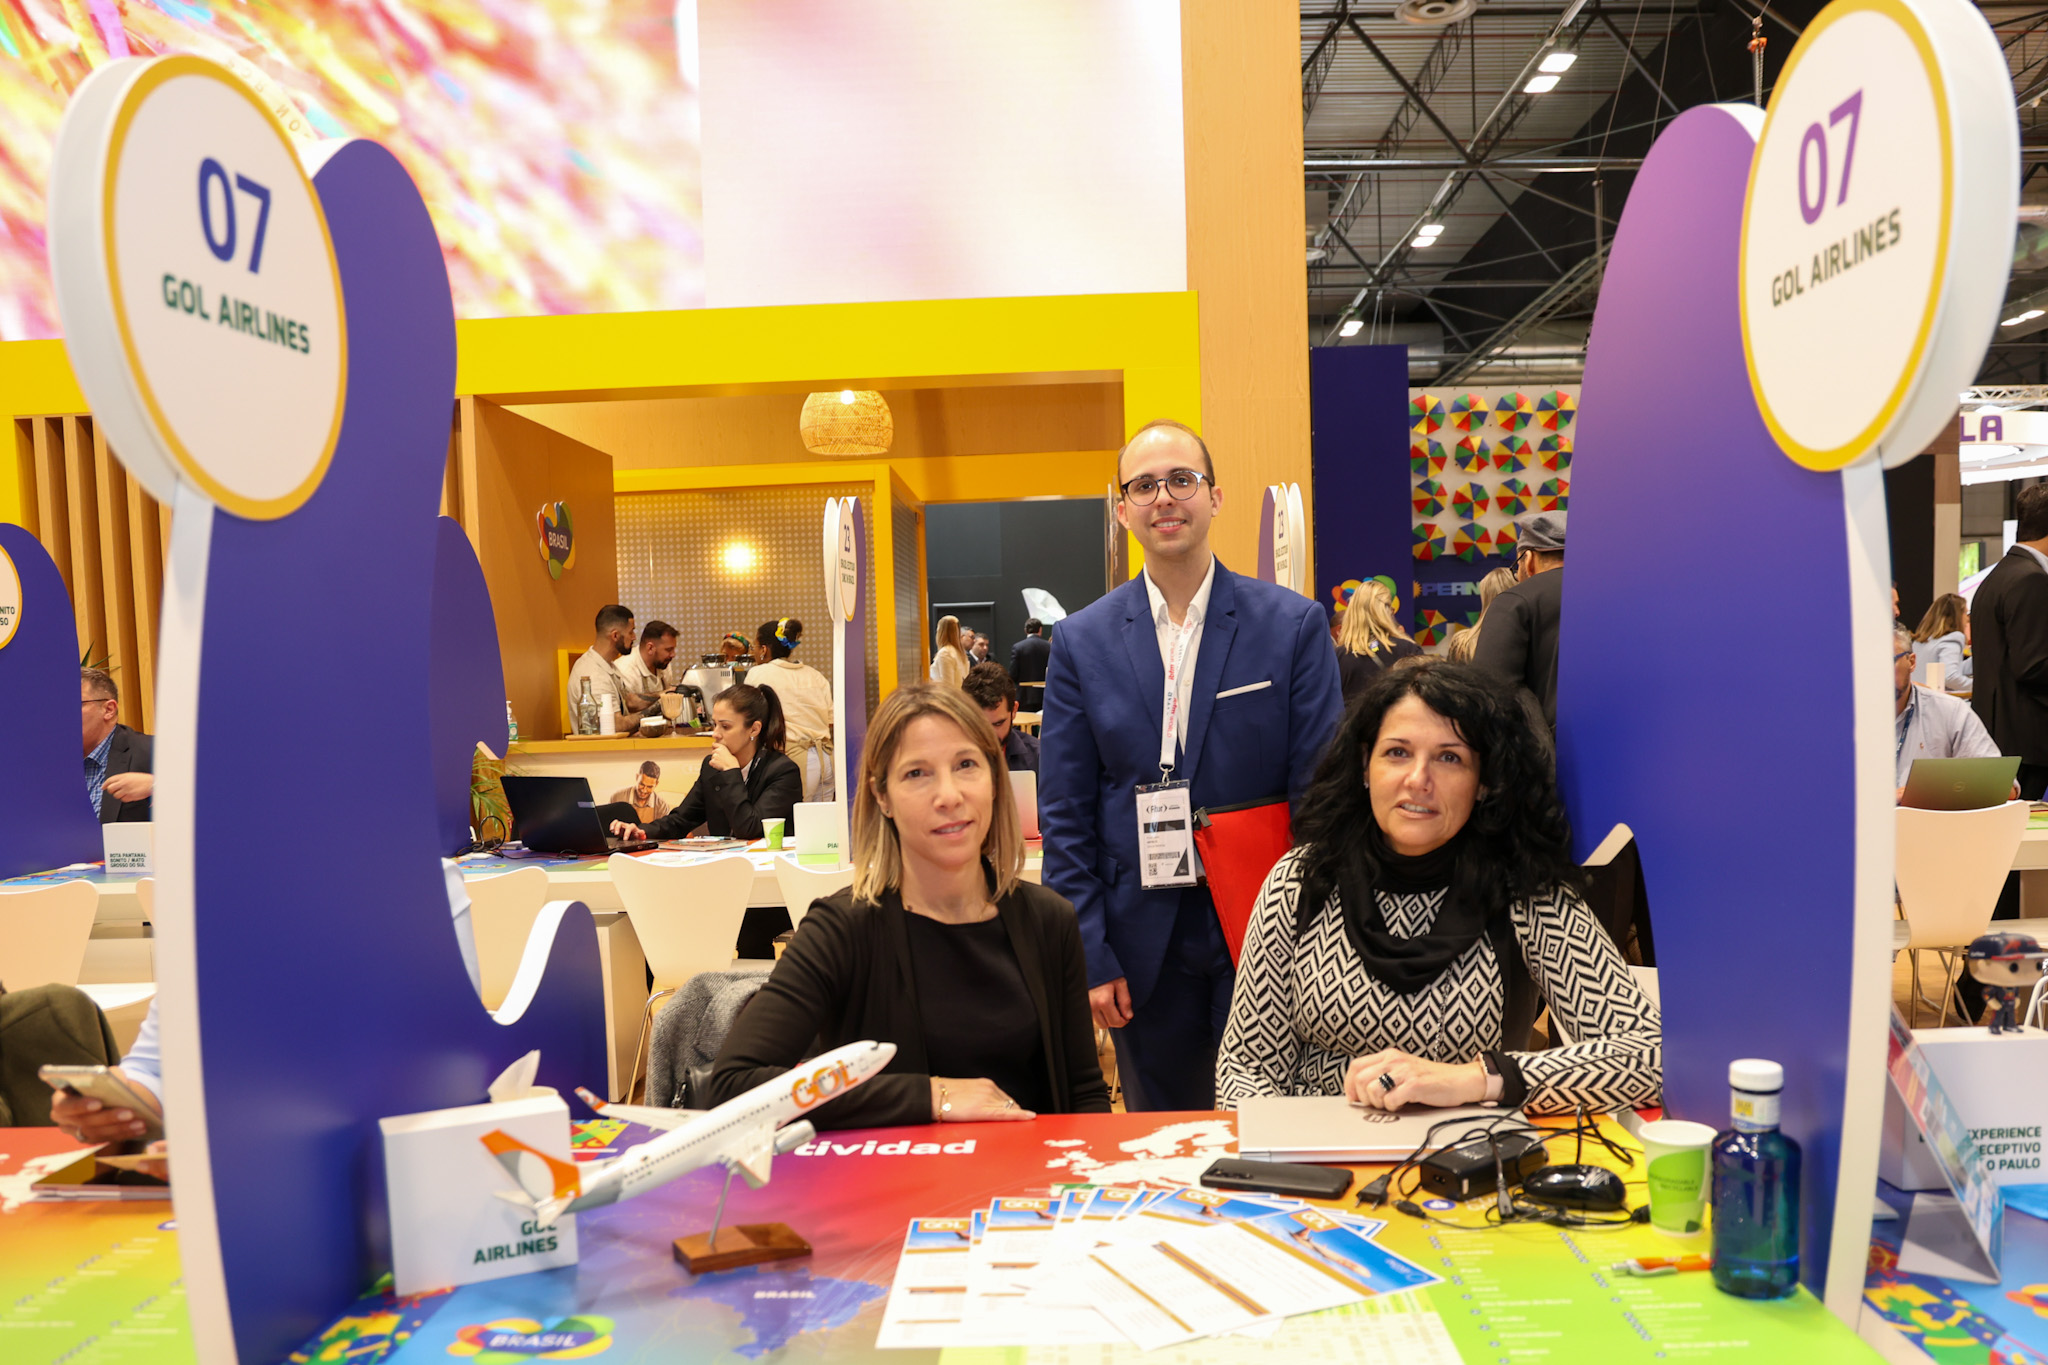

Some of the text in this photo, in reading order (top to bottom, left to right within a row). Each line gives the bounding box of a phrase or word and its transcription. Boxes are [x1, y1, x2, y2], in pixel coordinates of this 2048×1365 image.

[1797, 86, 1863, 226] 07
[198, 155, 271, 275] 07
[1771, 207, 1901, 307] GOL AIRLINES
[162, 272, 311, 355] GOL AIRLINES
[548, 531, 569, 550] BRASIL
[844, 524, 851, 553] 23
[792, 1059, 858, 1109] GOL
[1978, 1142, 2041, 1155] ECEPTIVO
[1999, 1158, 2041, 1170] PAULO
[1004, 1200, 1044, 1209] GOL
[1186, 1190, 1221, 1205] GOL
[923, 1220, 964, 1230] GOL
[1301, 1211, 1332, 1229] GOL
[473, 1236, 558, 1265] AIRLINES
[754, 1290, 816, 1299] BRASIL
[489, 1333, 577, 1347] BRASIL
